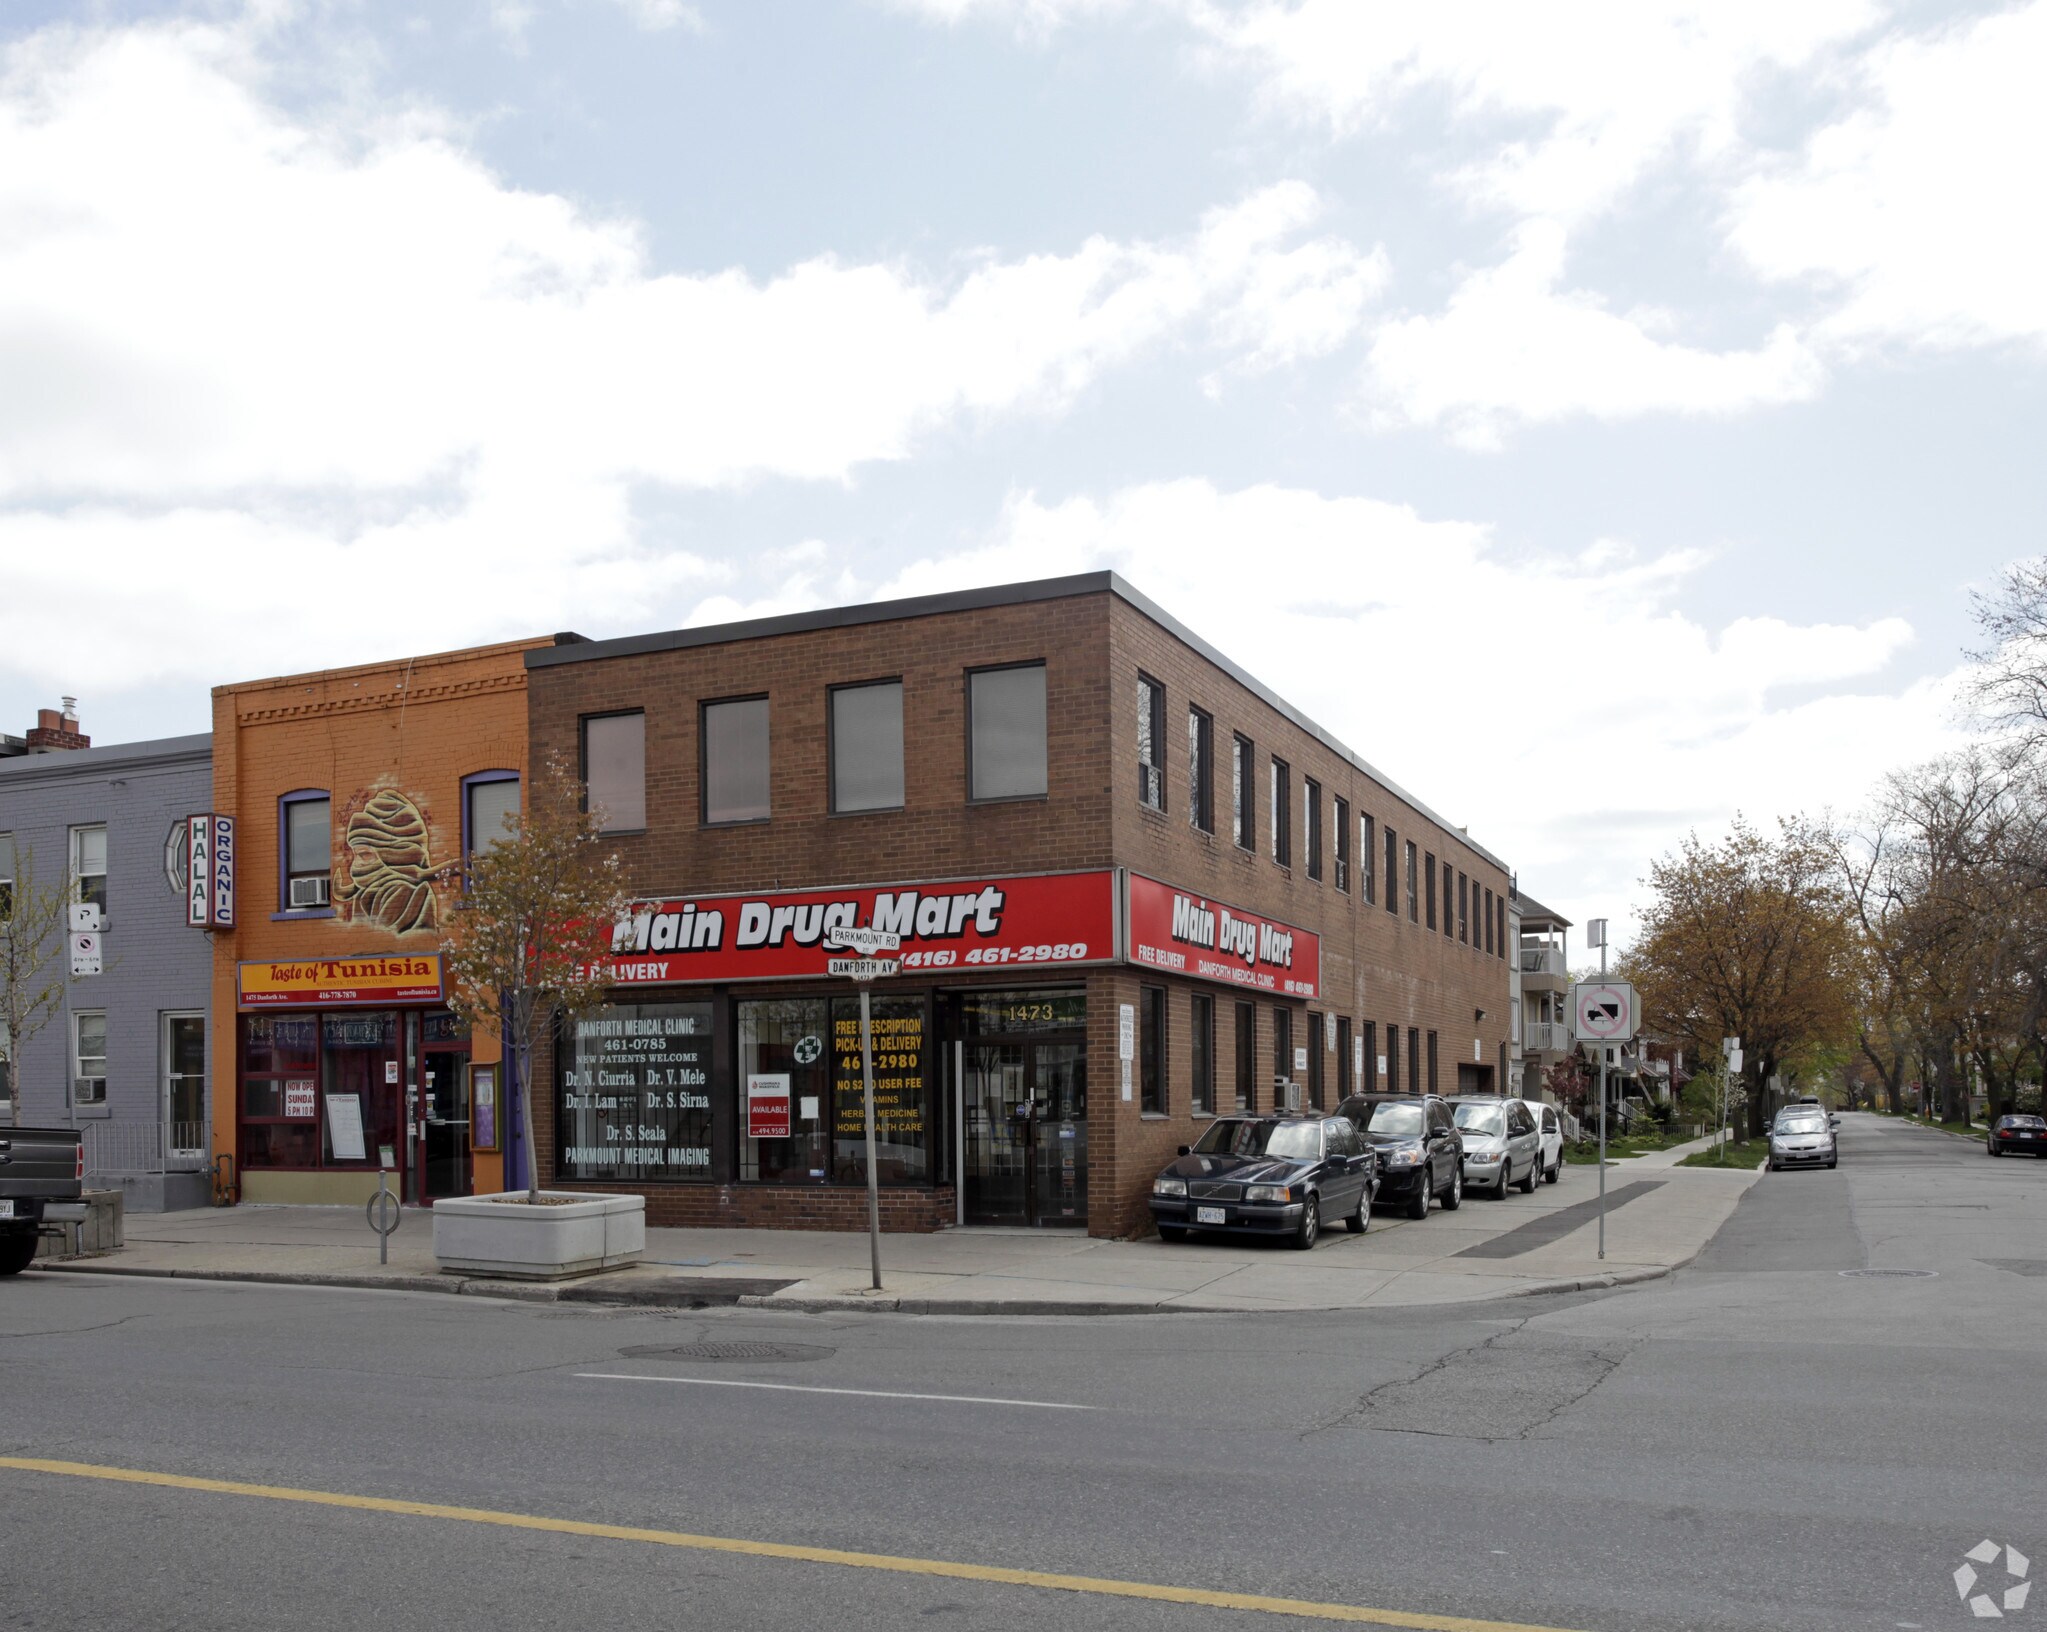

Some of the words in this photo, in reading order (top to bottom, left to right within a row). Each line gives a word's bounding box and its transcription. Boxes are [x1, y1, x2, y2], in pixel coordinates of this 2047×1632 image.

[192, 822, 206, 920] HALAL
[216, 820, 231, 920] ORGANIC
[611, 903, 724, 953] Main
[736, 901, 858, 952] Drug
[871, 886, 1004, 937] Mart
[834, 930, 883, 945] PARKMOUNT
[886, 936, 897, 947] RD
[1172, 894, 1216, 949] Main
[1220, 909, 1257, 965] Drug
[1259, 922, 1293, 968] Mart
[900, 950, 957, 967] (416)
[965, 943, 1088, 963] 461-2980
[1138, 944, 1155, 963] FREE
[1156, 949, 1186, 969] DELIVERY
[270, 964, 302, 983] Taste
[305, 963, 318, 984] of
[320, 958, 432, 979] Tunisia
[590, 962, 669, 980] DLIVERY
[833, 962, 876, 973] DANFORTH
[882, 962, 894, 973] AV
[1199, 960, 1232, 980] DANFORTH
[1232, 967, 1257, 985] MEDICAL
[1258, 974, 1275, 989] CLINIC
[318, 991, 356, 1000] 416-778-7870
[1284, 979, 1295, 992] (416)
[1295, 981, 1314, 996] 461-2980
[1010, 1004, 1053, 1021] 1473
[578, 1020, 622, 1037] DANFORTH
[625, 1018, 662, 1036] MEDICAL
[665, 1018, 695, 1035] CLINIC
[835, 1020, 857, 1035] FREE
[604, 1038, 666, 1050] 461-0785
[872, 1036, 878, 1051] &
[880, 1036, 922, 1050] DELIVERY
[576, 1055, 597, 1064] NEW
[600, 1054, 646, 1063] PATIENTS
[649, 1053, 698, 1062] WELCOME
[842, 1054, 918, 1070] 46-2980
[566, 1070, 581, 1086] Dr.
[584, 1070, 595, 1086] N.
[598, 1070, 636, 1086] Ciurria
[647, 1069, 663, 1085] Dr.
[666, 1069, 677, 1085] V.
[680, 1068, 706, 1085] Mele
[837, 1080, 850, 1090] NO
[880, 1078, 903, 1089] USER
[905, 1078, 922, 1088] FEE
[288, 1081, 300, 1091] NOW
[566, 1093, 582, 1109] Dr.
[594, 1092, 617, 1108] Lam
[647, 1092, 663, 1108] Dr.
[666, 1092, 677, 1108] S.
[680, 1092, 709, 1108] Sirna
[860, 1095, 899, 1104] VAMINS
[288, 1106, 291, 1115] 5
[292, 1106, 300, 1115] PM
[302, 1106, 308, 1115] 10
[841, 1109, 875, 1118] HERB
[878, 1109, 918, 1117] MEDICINE
[606, 1125, 622, 1141] Dr.
[625, 1125, 635, 1141] S.
[638, 1124, 666, 1141] Scala
[837, 1123, 862, 1132] HOME
[899, 1122, 923, 1131] CARE
[565, 1148, 622, 1164] PARKMOUNT
[624, 1148, 664, 1164] MEDICAL
[668, 1148, 709, 1165] IMAGING
